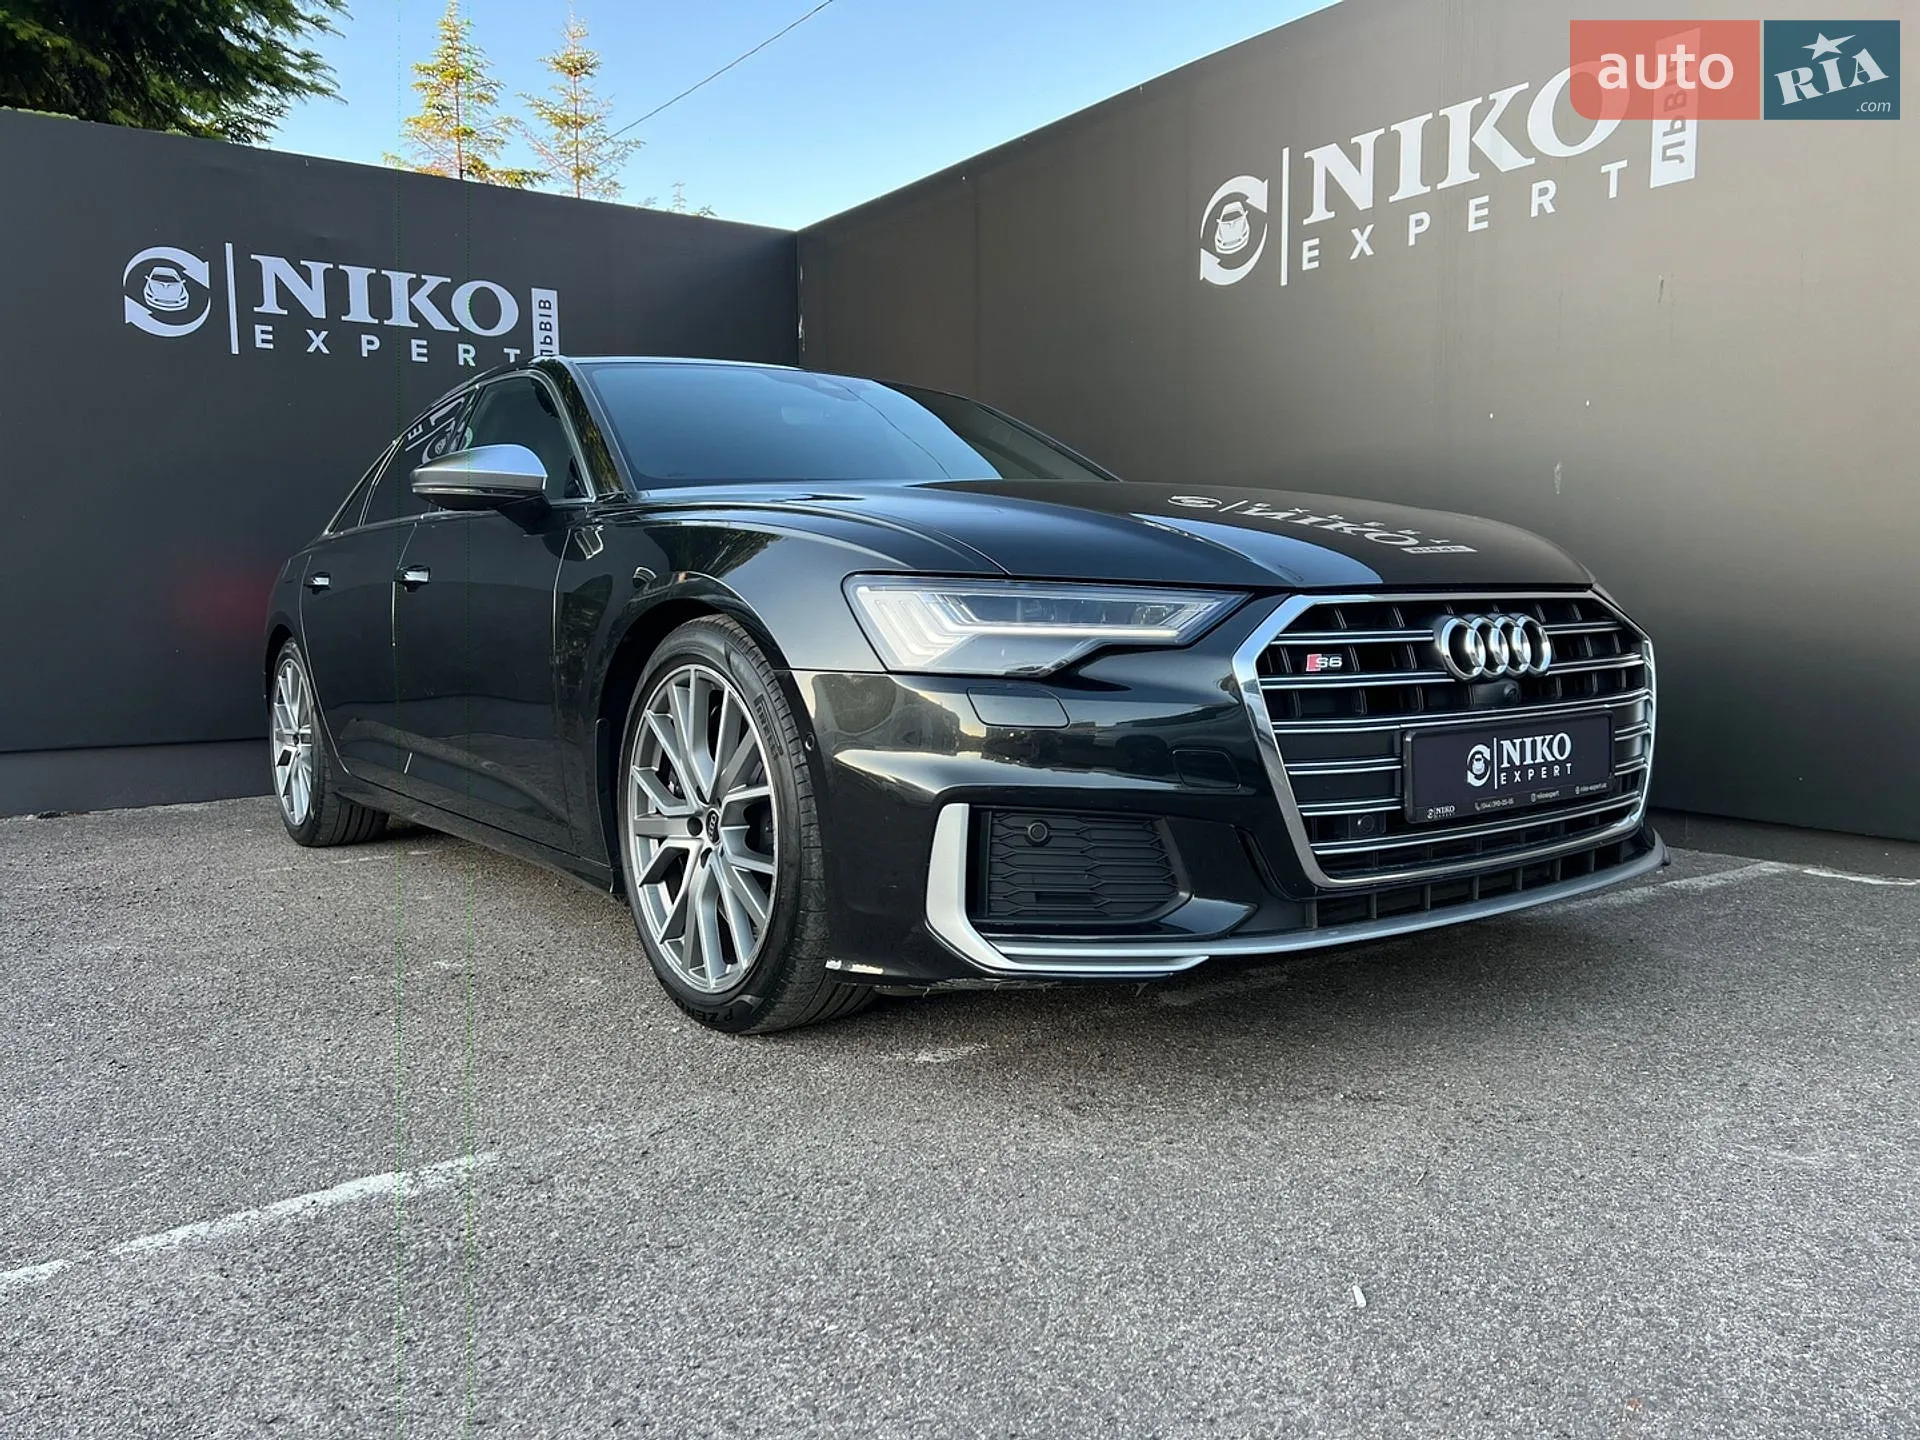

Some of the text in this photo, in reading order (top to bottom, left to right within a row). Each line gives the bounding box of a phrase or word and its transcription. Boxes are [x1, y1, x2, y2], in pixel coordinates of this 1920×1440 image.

[1303, 60, 1630, 226] NIKO
[1301, 159, 1628, 271] EXPERT
[250, 253, 520, 338] NIKO
[254, 323, 521, 368] EXPERT
[1314, 656, 1343, 669] S6
[1500, 732, 1572, 768] NIKO
[1501, 763, 1573, 785] EXPERT
